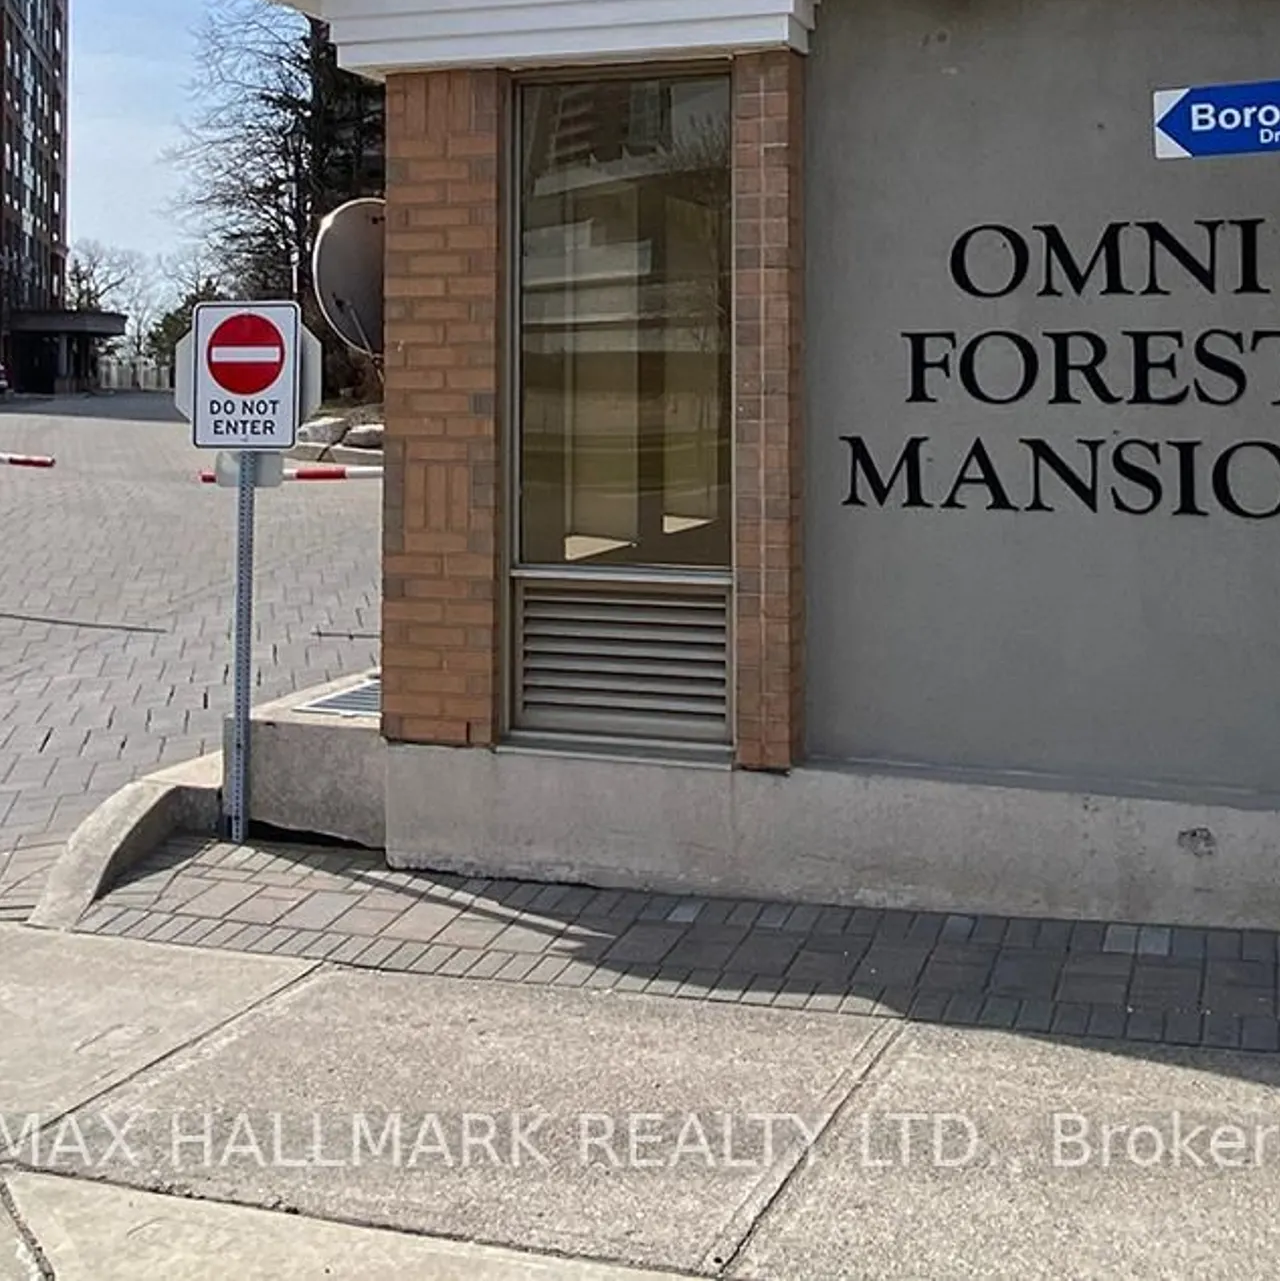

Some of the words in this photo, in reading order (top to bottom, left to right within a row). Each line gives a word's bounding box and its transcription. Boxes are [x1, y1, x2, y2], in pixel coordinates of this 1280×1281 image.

[949, 218, 1271, 298] OMNI
[209, 399, 235, 415] DO
[242, 399, 280, 415] NOT
[213, 419, 276, 435] ENTER
